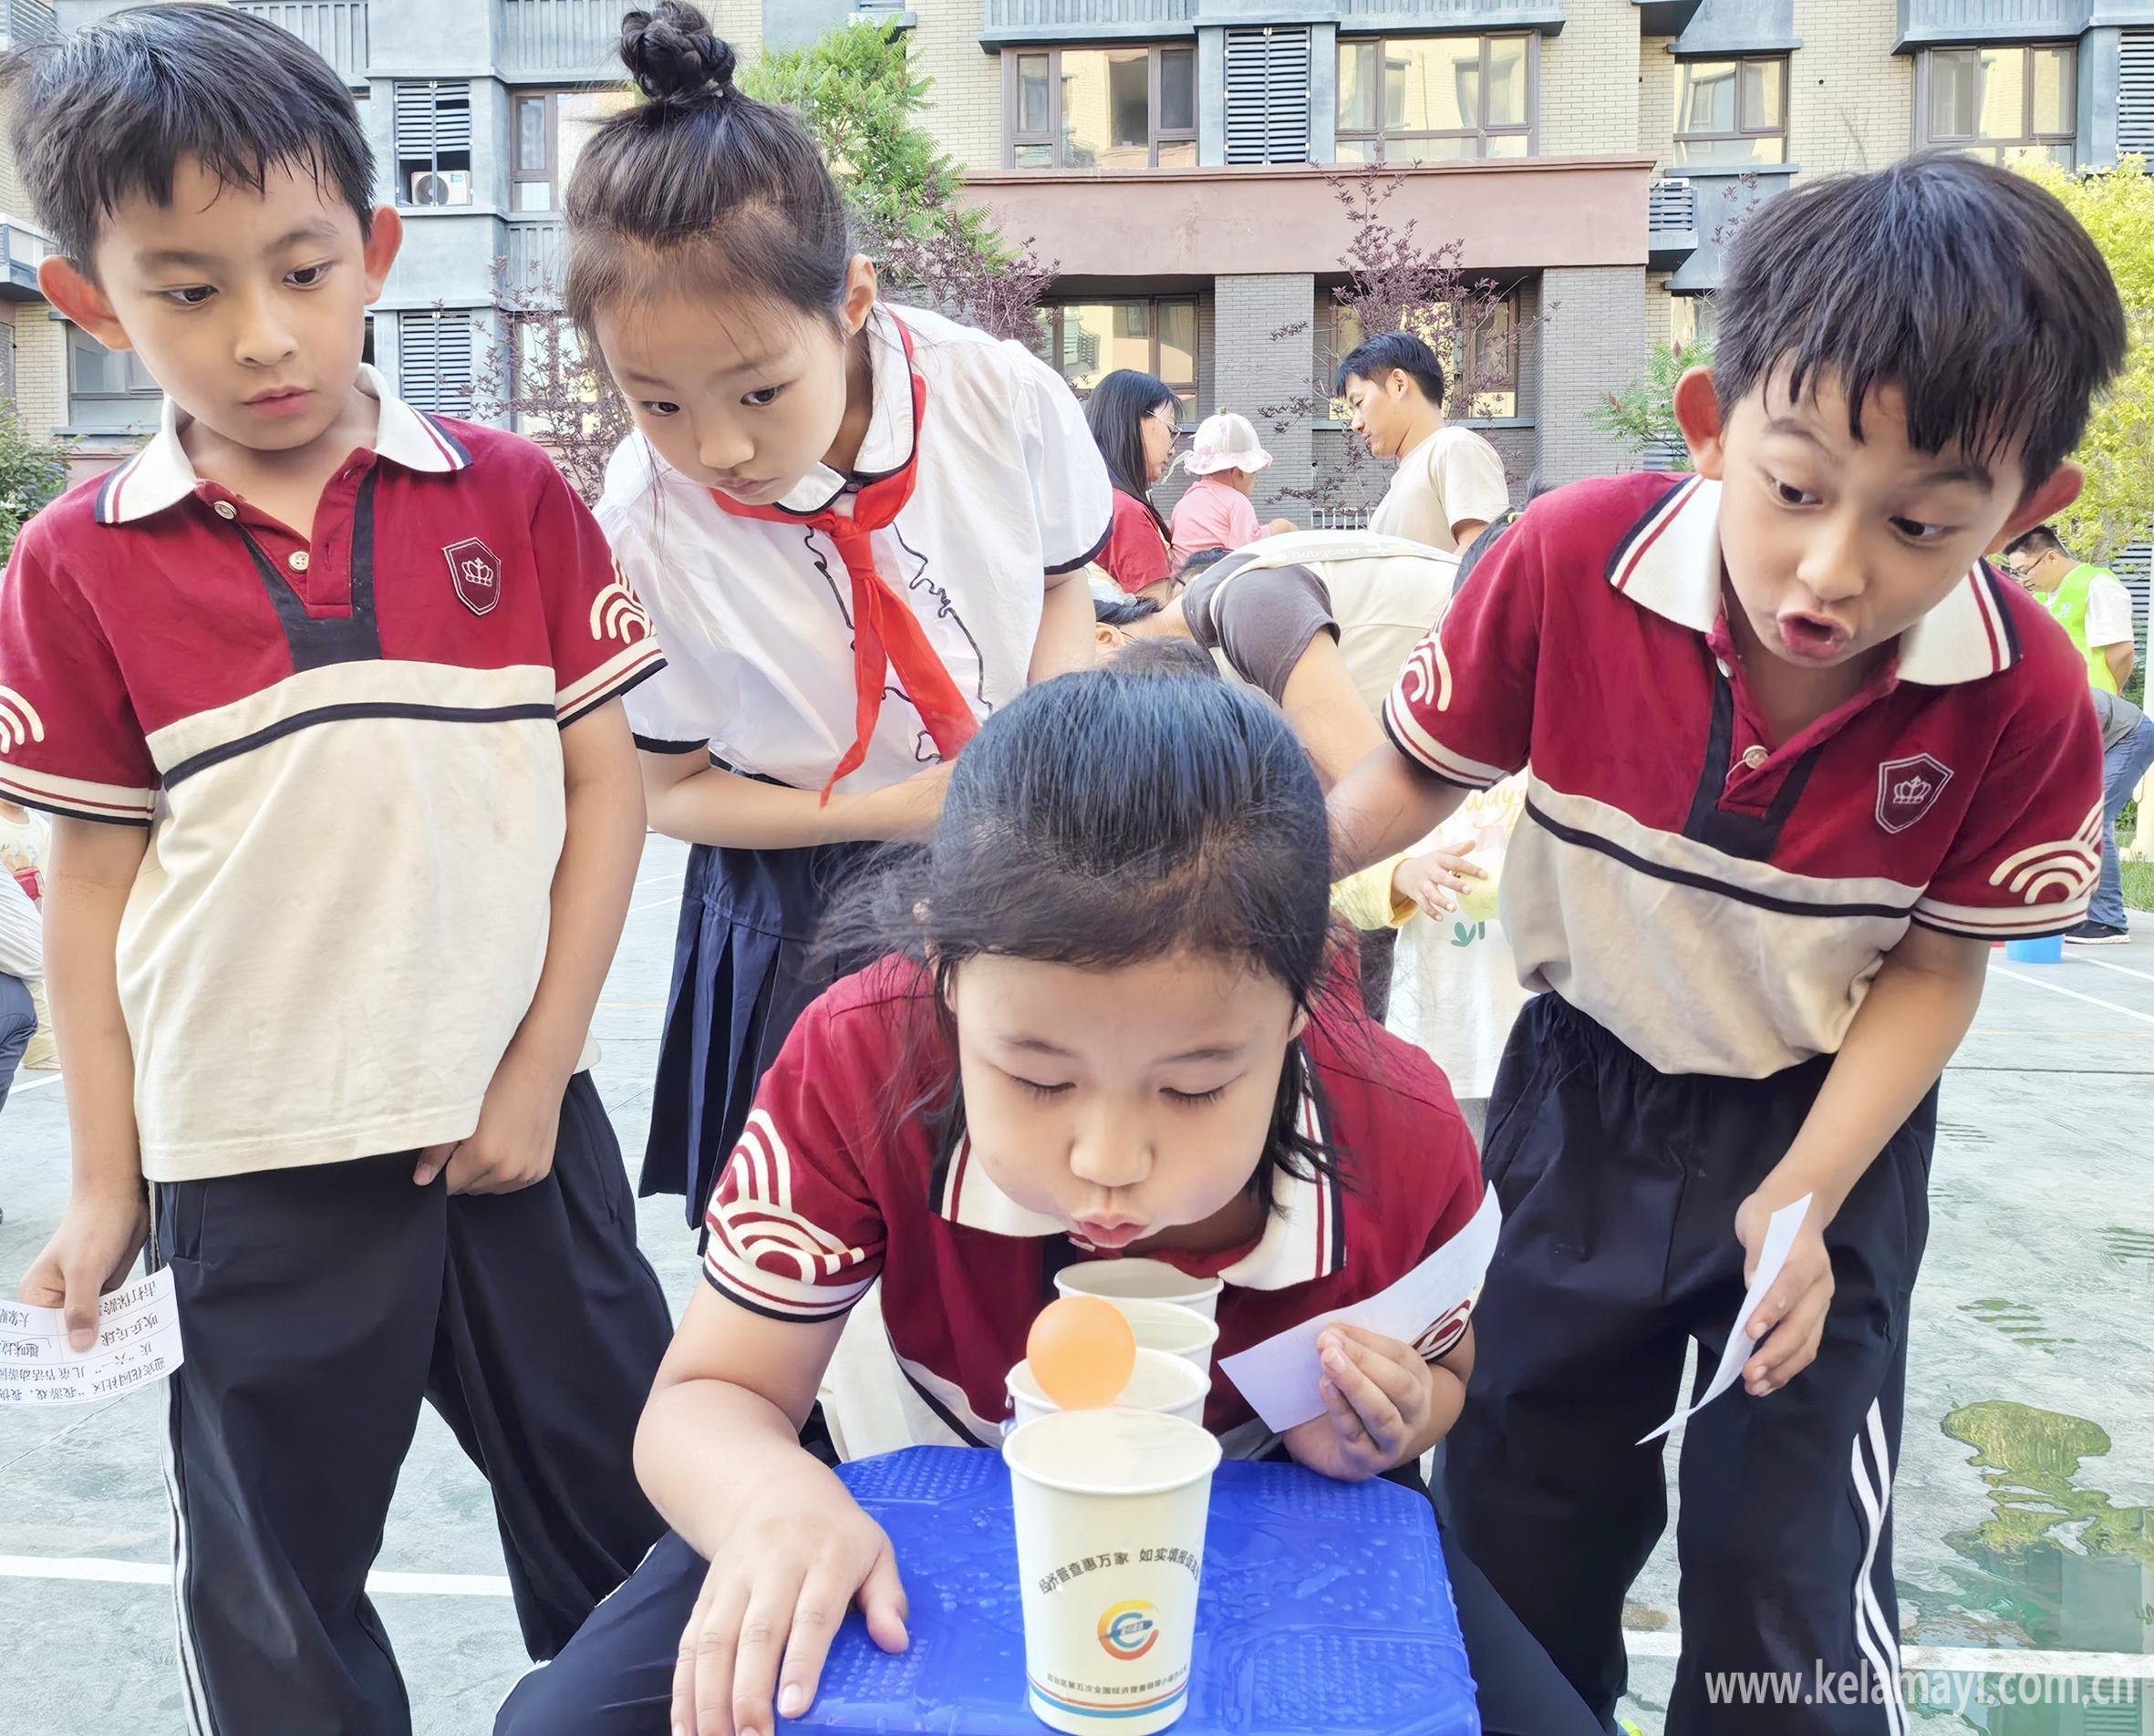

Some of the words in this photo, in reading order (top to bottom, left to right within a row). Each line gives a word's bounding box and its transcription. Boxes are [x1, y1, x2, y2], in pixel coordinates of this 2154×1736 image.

[99, 1280, 156, 1316] 击打保龄
[101, 1312, 158, 1347] 吹乒乓球
[1139, 1548, 1199, 1582] 如实填报促发
